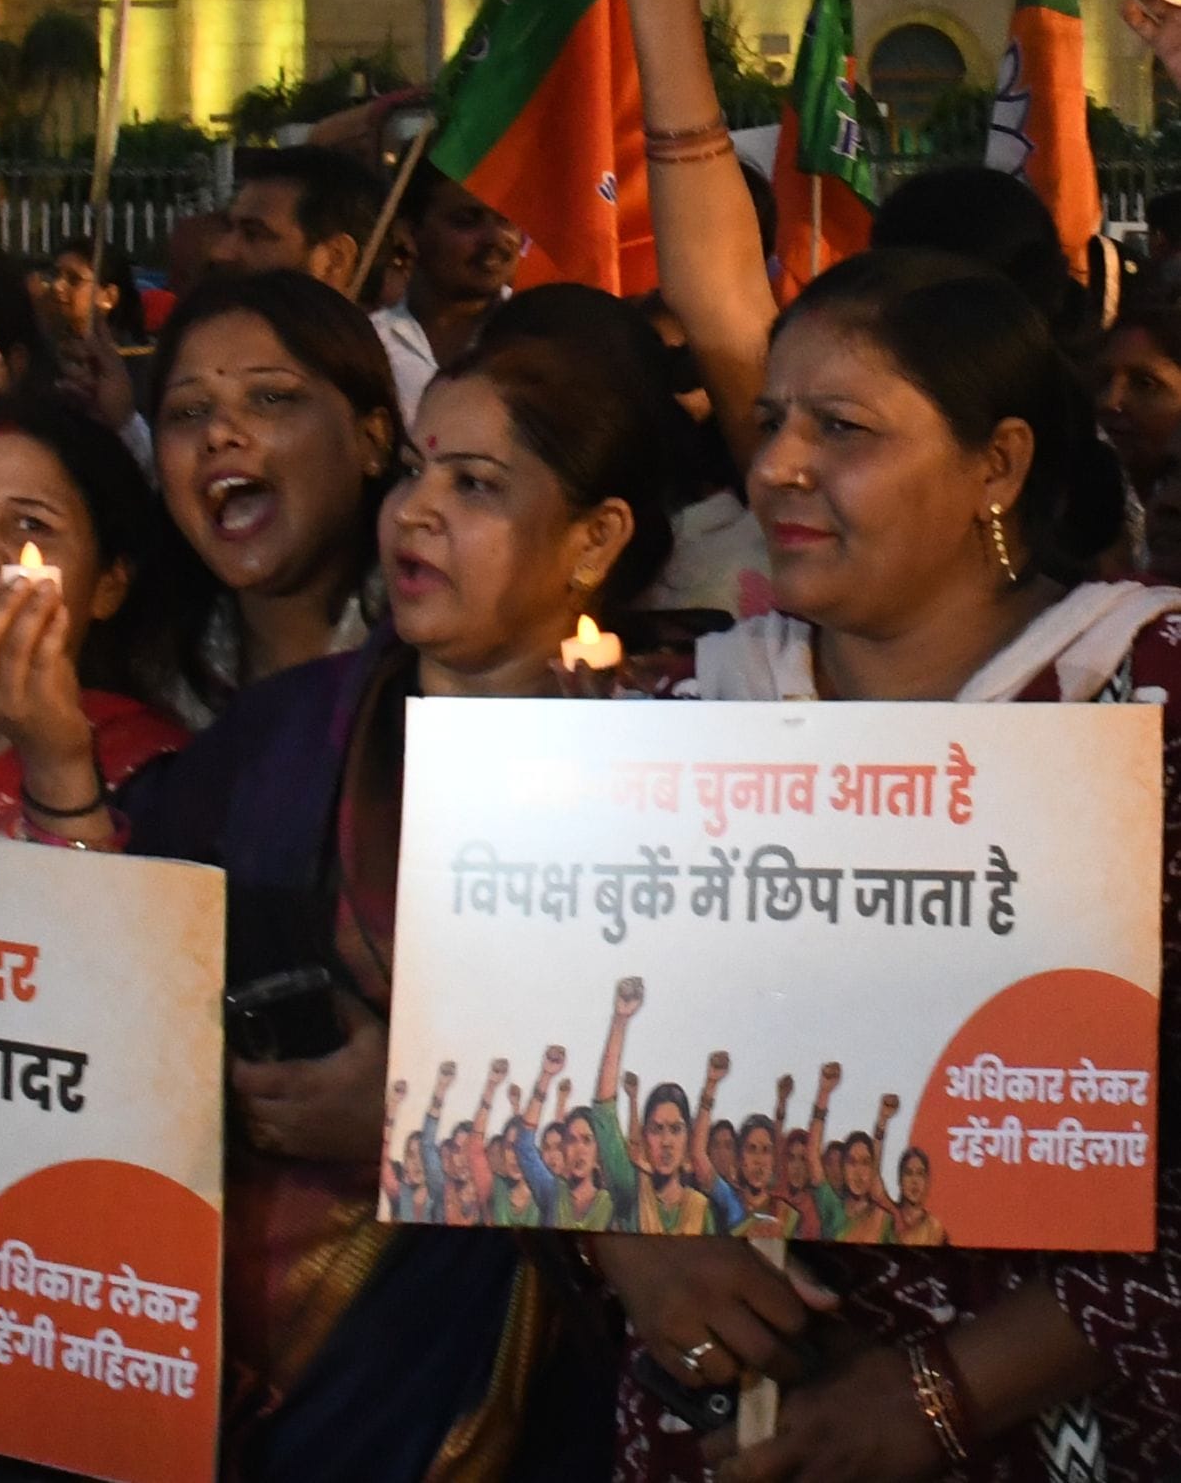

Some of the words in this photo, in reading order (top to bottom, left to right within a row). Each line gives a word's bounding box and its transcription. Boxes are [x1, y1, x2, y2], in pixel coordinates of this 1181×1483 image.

[691, 763, 819, 838] चुनाव
[829, 763, 938, 817] आता
[945, 741, 977, 826] है
[450, 839, 584, 923] विपक्ष
[687, 845, 742, 923] में
[744, 843, 845, 924] छिप
[852, 868, 976, 928] जाता
[985, 844, 1019, 937] है
[945, 1052, 1065, 1104] अधिकार
[1068, 1056, 1150, 1107] लेकर
[946, 1114, 1025, 1168] रहेंगी
[1026, 1116, 1149, 1171] महिलाएं
[105, 1262, 201, 1331] लेकर
[59, 1326, 199, 1399] महिलाएं
